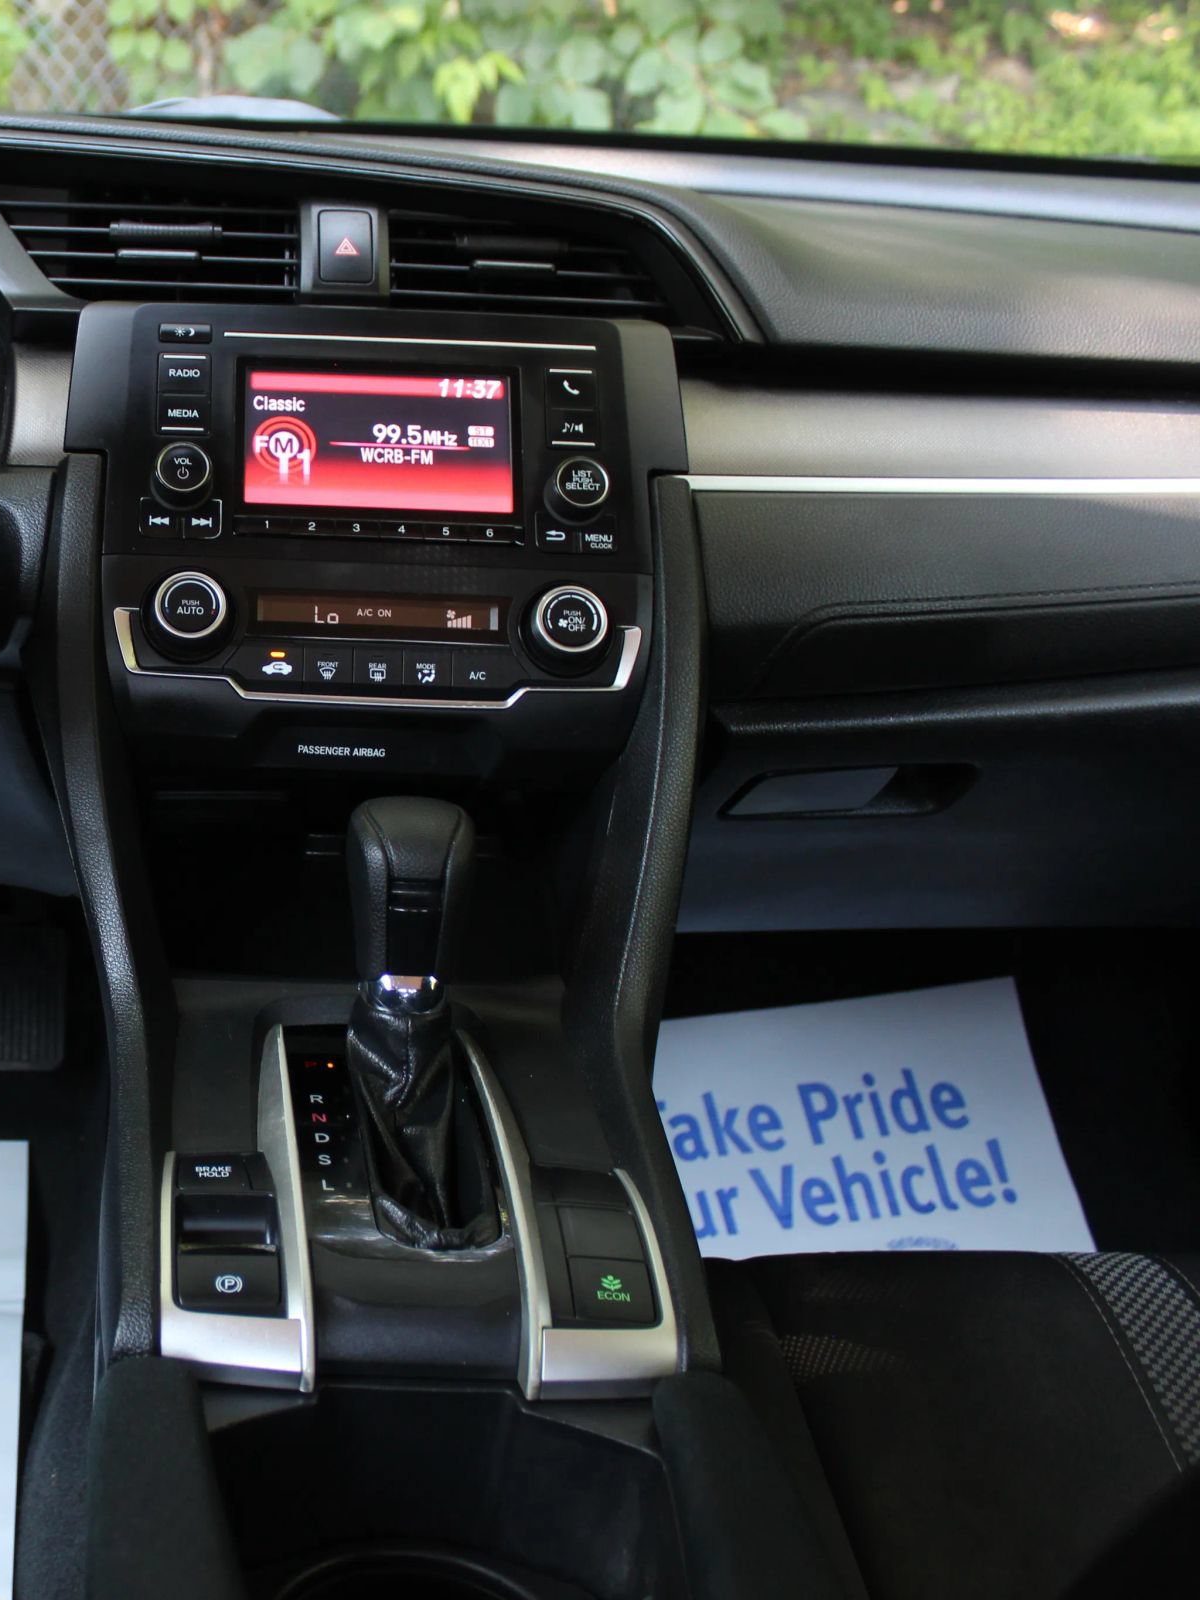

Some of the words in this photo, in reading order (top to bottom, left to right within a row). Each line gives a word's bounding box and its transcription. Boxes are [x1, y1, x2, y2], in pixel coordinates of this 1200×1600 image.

[169, 368, 201, 379] RADIO
[438, 378, 503, 399] 11:37
[253, 395, 306, 412] Classic
[167, 408, 200, 419] MEDIA
[173, 457, 193, 466] VOL
[360, 447, 434, 466] WCRB-FM
[572, 470, 593, 478] LIST
[565, 482, 601, 491] SELECT
[264, 520, 270, 529] 1
[308, 521, 317, 532] 2
[352, 523, 361, 533] 3
[398, 524, 406, 535] 4
[442, 526, 451, 536] 5
[486, 528, 495, 538] 6
[584, 533, 613, 543] MENU
[176, 606, 205, 616] AUTO
[356, 608, 374, 617] A/C
[377, 608, 392, 618] ON
[563, 609, 582, 617] PUSH
[567, 624, 587, 632] OFF
[317, 660, 339, 668] FRONT
[469, 671, 487, 681] A/C
[297, 744, 351, 757] PASSENGER
[352, 747, 386, 758] AIRBAG
[309, 1094, 324, 1104] R
[311, 1112, 327, 1123] N
[655, 1091, 786, 1162] ake
[797, 1067, 970, 1146] Pride
[314, 1132, 330, 1143] D
[318, 1154, 332, 1166] S
[321, 1178, 336, 1191] L
[694, 1186, 738, 1239] ur
[748, 1138, 1018, 1230] Vehicle!
[596, 1289, 631, 1302] ECON
